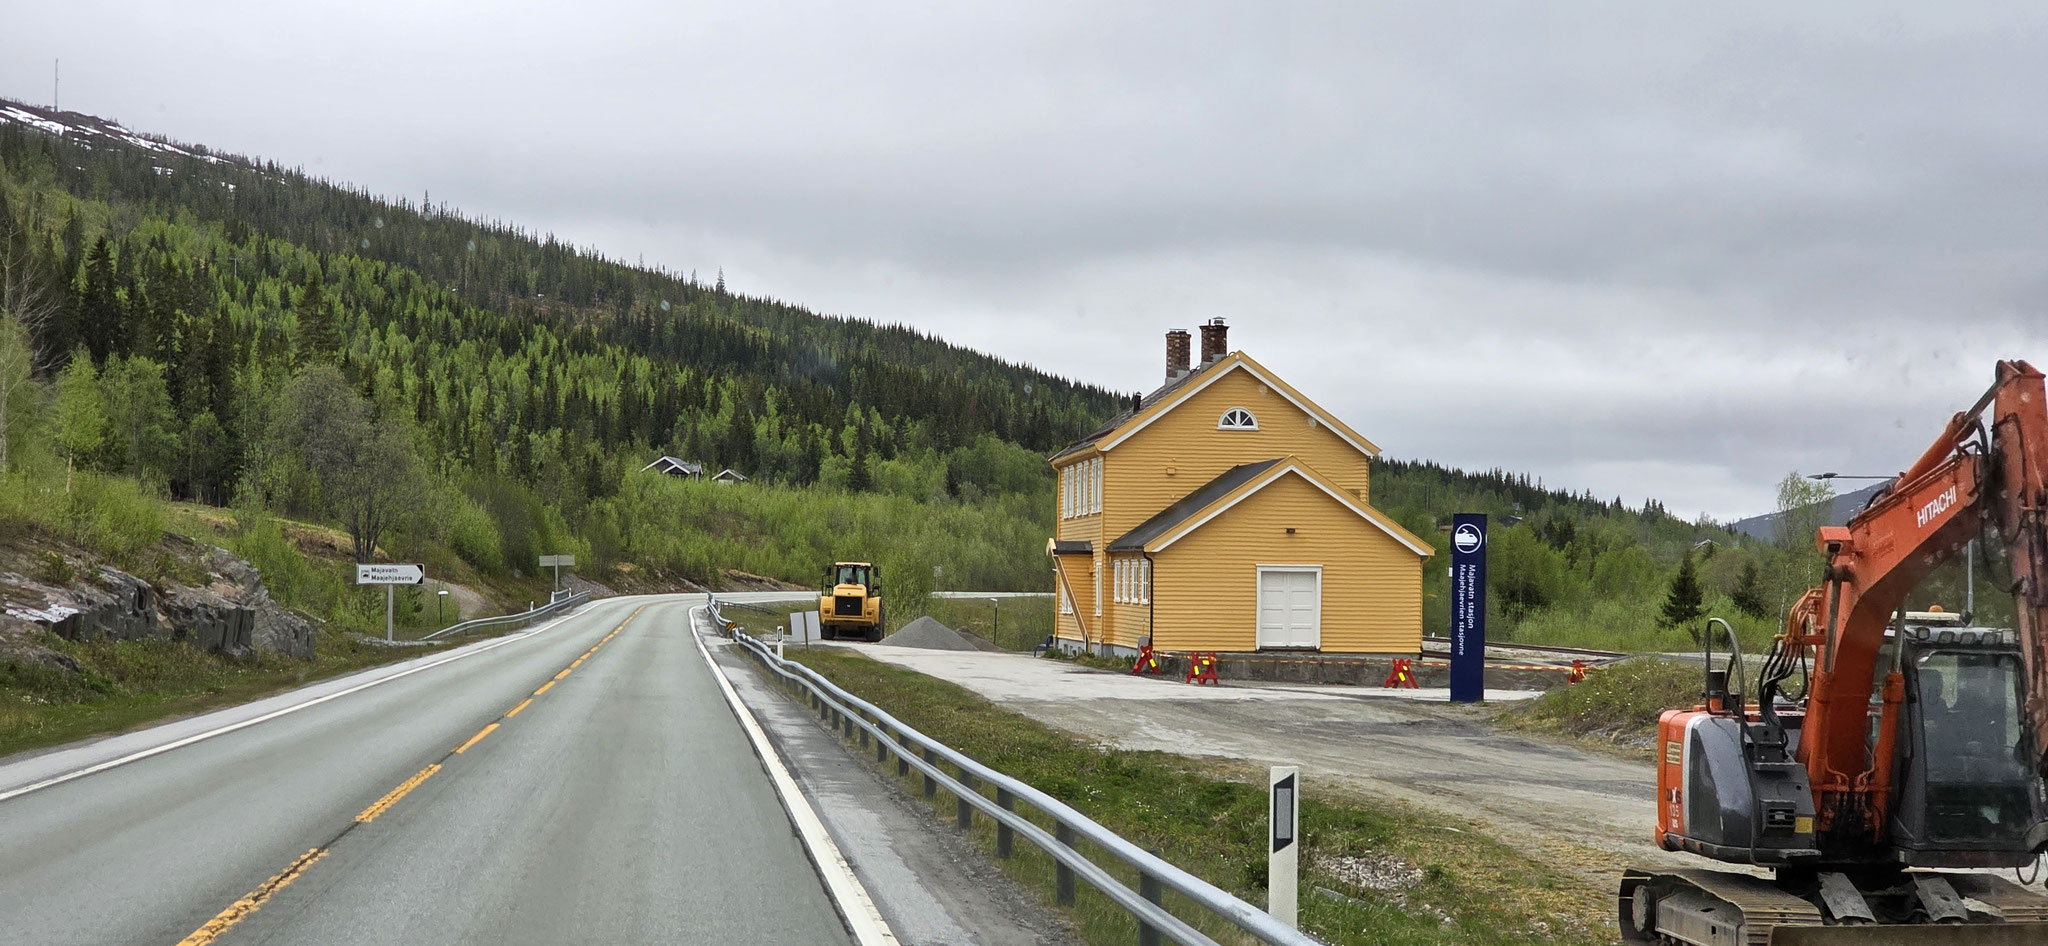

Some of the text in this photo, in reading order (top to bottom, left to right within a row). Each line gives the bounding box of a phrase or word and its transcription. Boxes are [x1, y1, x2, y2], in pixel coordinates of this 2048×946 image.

[1917, 485, 1956, 528] HITACHI
[1457, 564, 1466, 656] Maajehjaevrien stasjovne
[1466, 564, 1476, 629] Majavatn stasjon
[1669, 804, 1680, 817] 135
